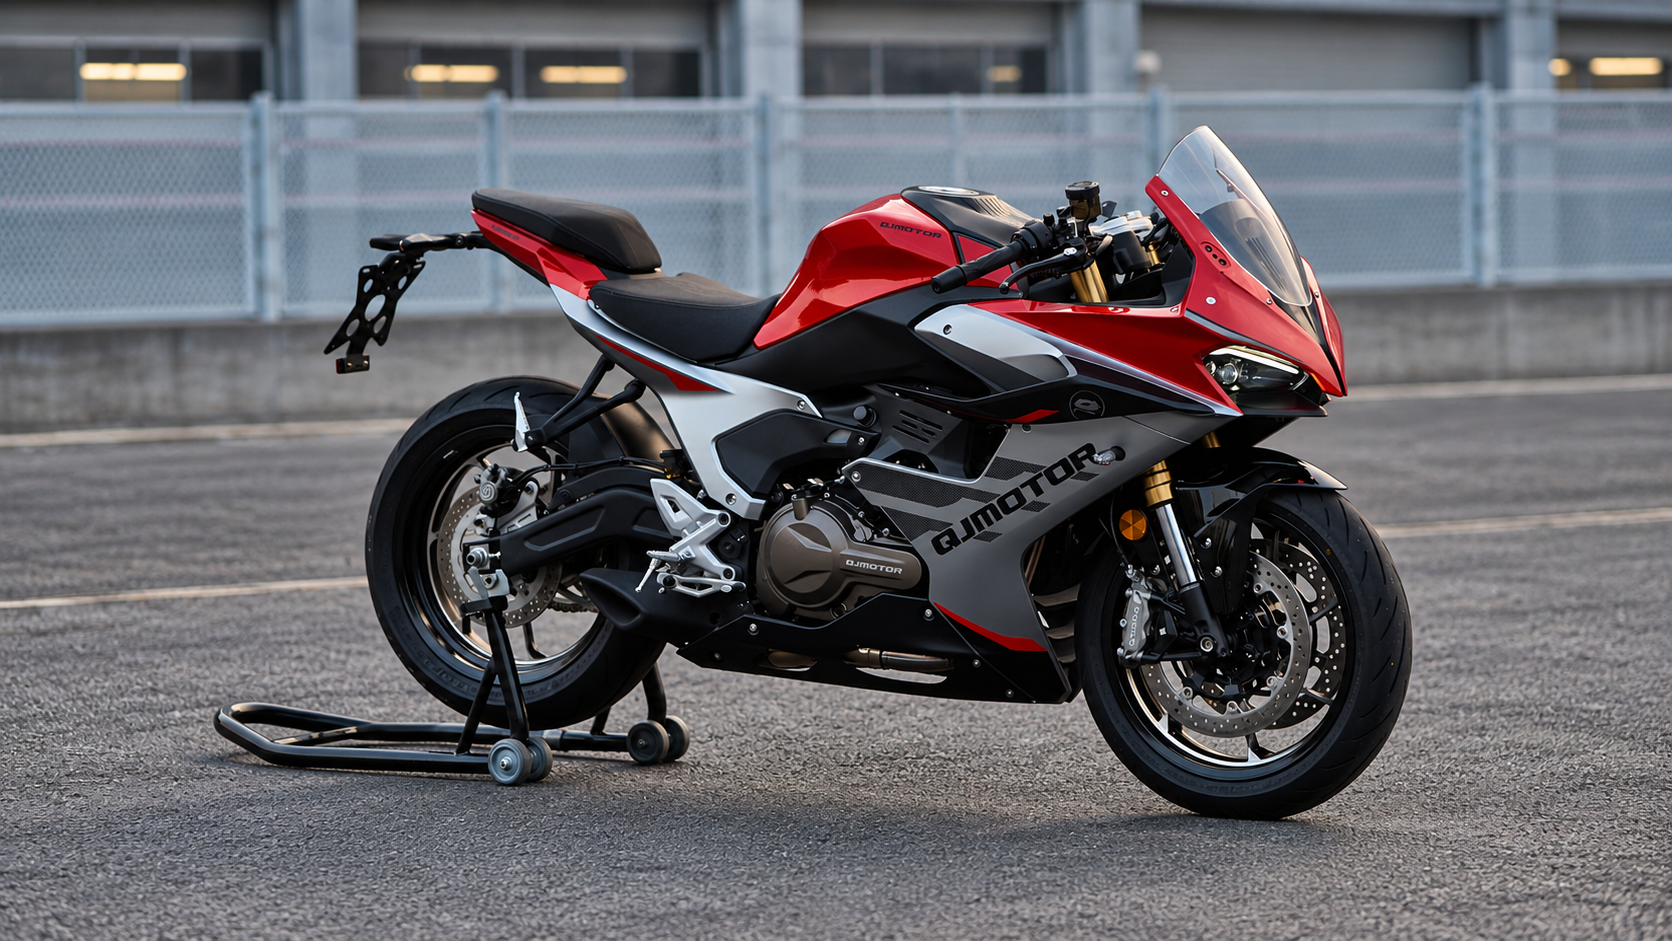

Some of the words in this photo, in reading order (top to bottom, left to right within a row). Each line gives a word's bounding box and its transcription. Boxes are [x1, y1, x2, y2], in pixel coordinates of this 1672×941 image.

[880, 222, 942, 238] QJMOTOR
[931, 442, 1101, 556] QJMOTOR
[845, 559, 903, 575] QJMOTOR
